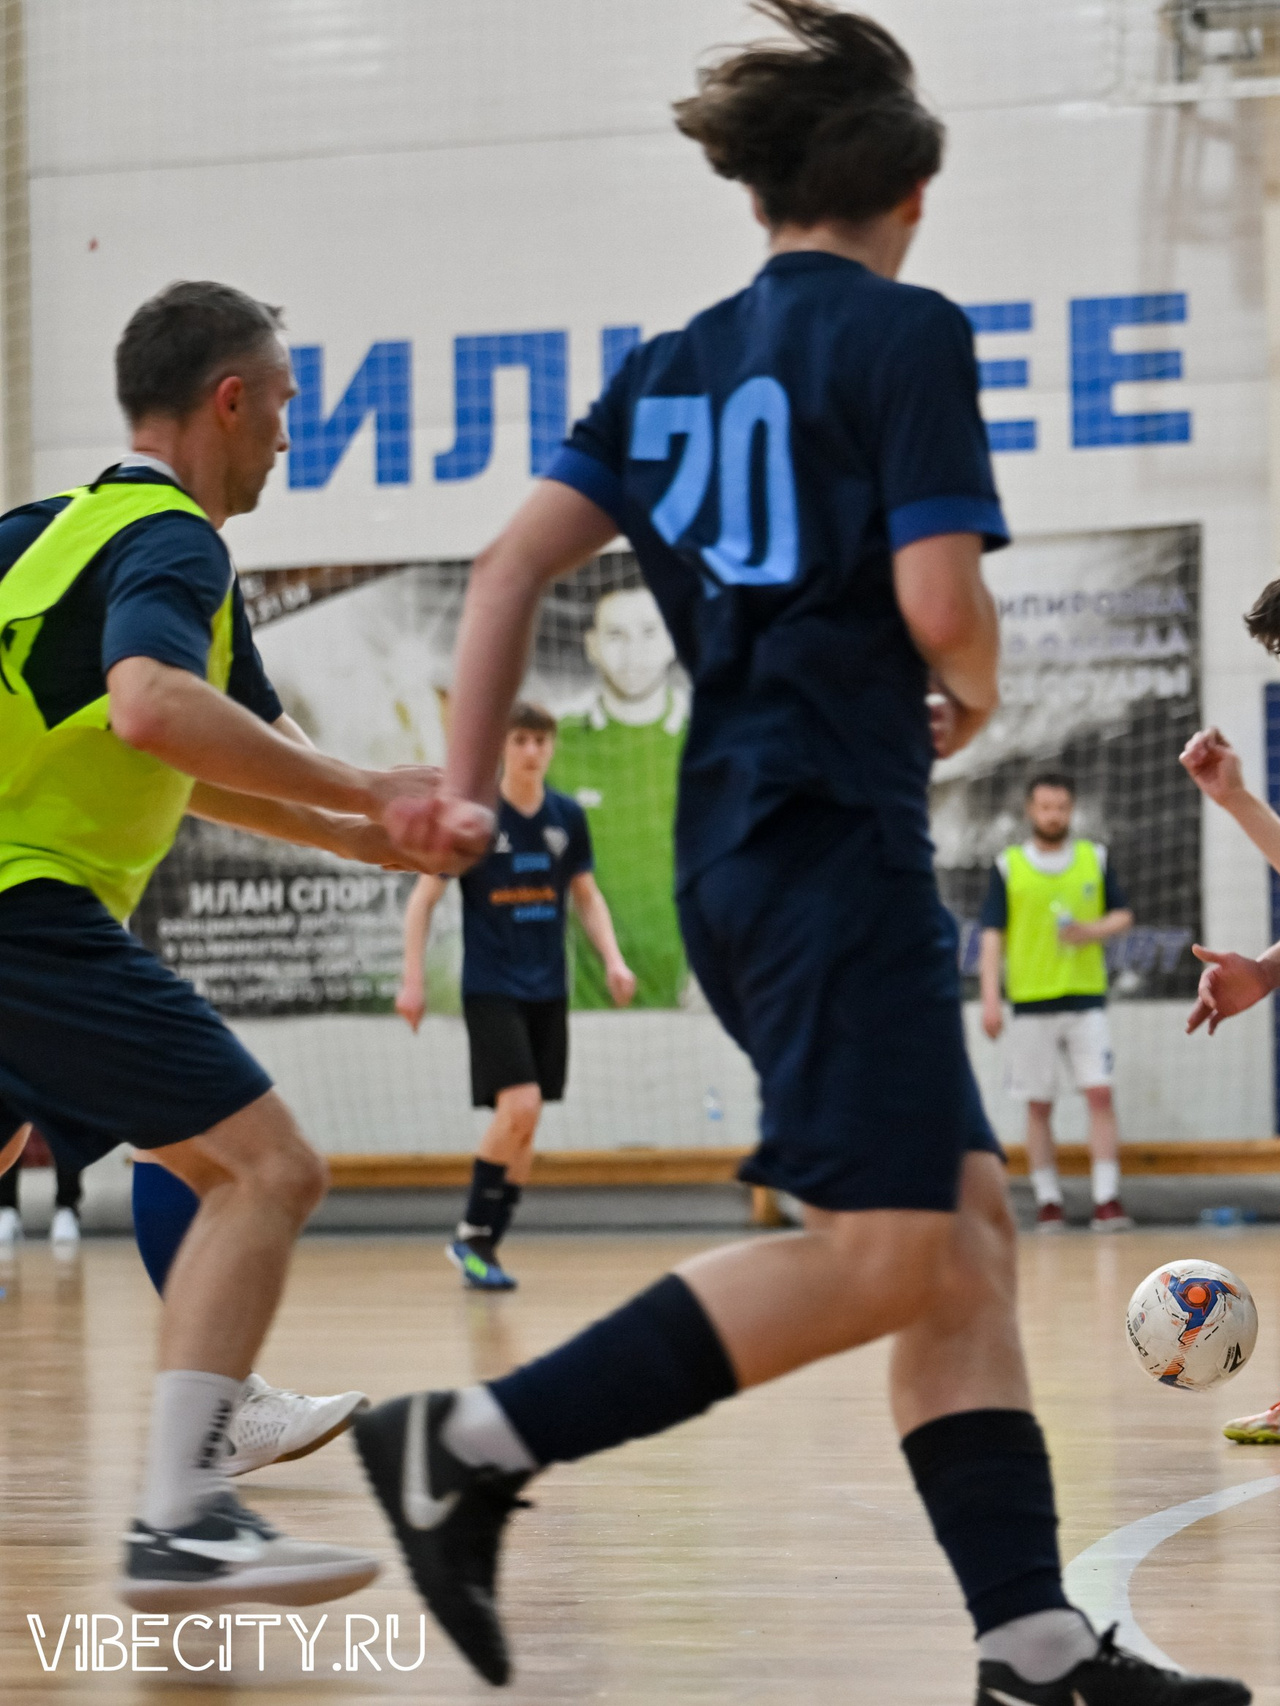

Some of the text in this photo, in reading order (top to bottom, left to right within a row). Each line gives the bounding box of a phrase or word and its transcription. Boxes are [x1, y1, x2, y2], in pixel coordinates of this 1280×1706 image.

[630, 375, 800, 586] 70
[189, 876, 401, 915] ИЛАН СПОРТ
